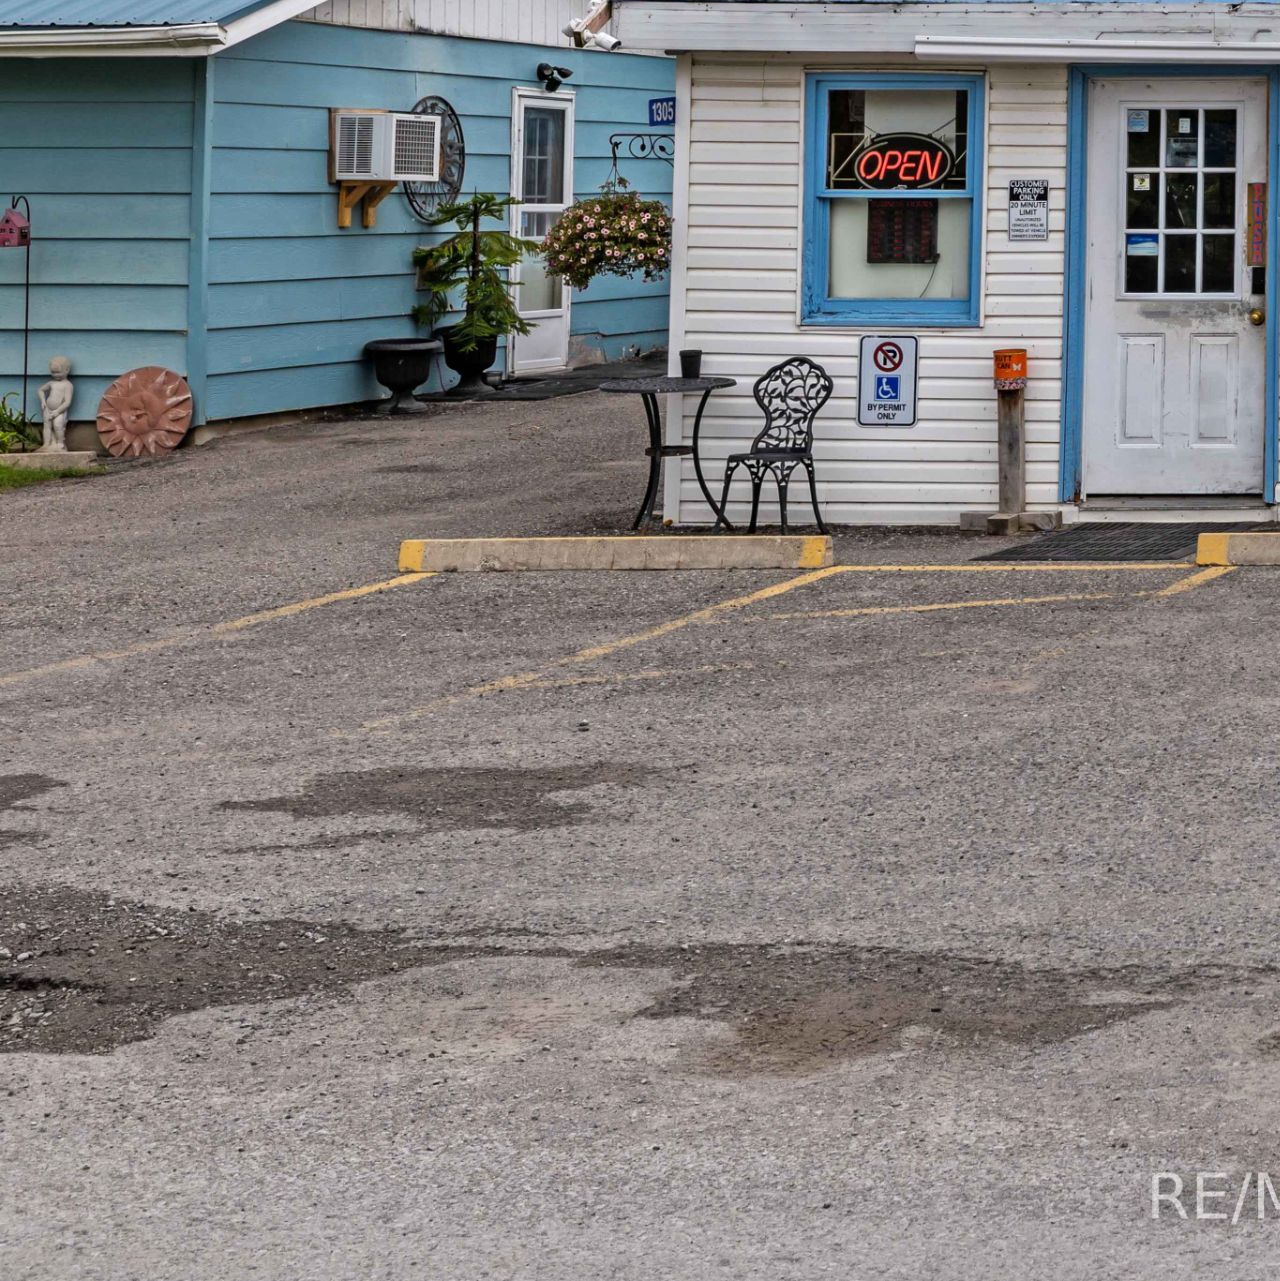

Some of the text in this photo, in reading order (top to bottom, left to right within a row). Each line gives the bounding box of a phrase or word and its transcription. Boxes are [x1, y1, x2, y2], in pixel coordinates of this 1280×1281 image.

[652, 101, 674, 122] 1305
[859, 151, 943, 180] OPEN
[877, 412, 896, 420] ONLY
